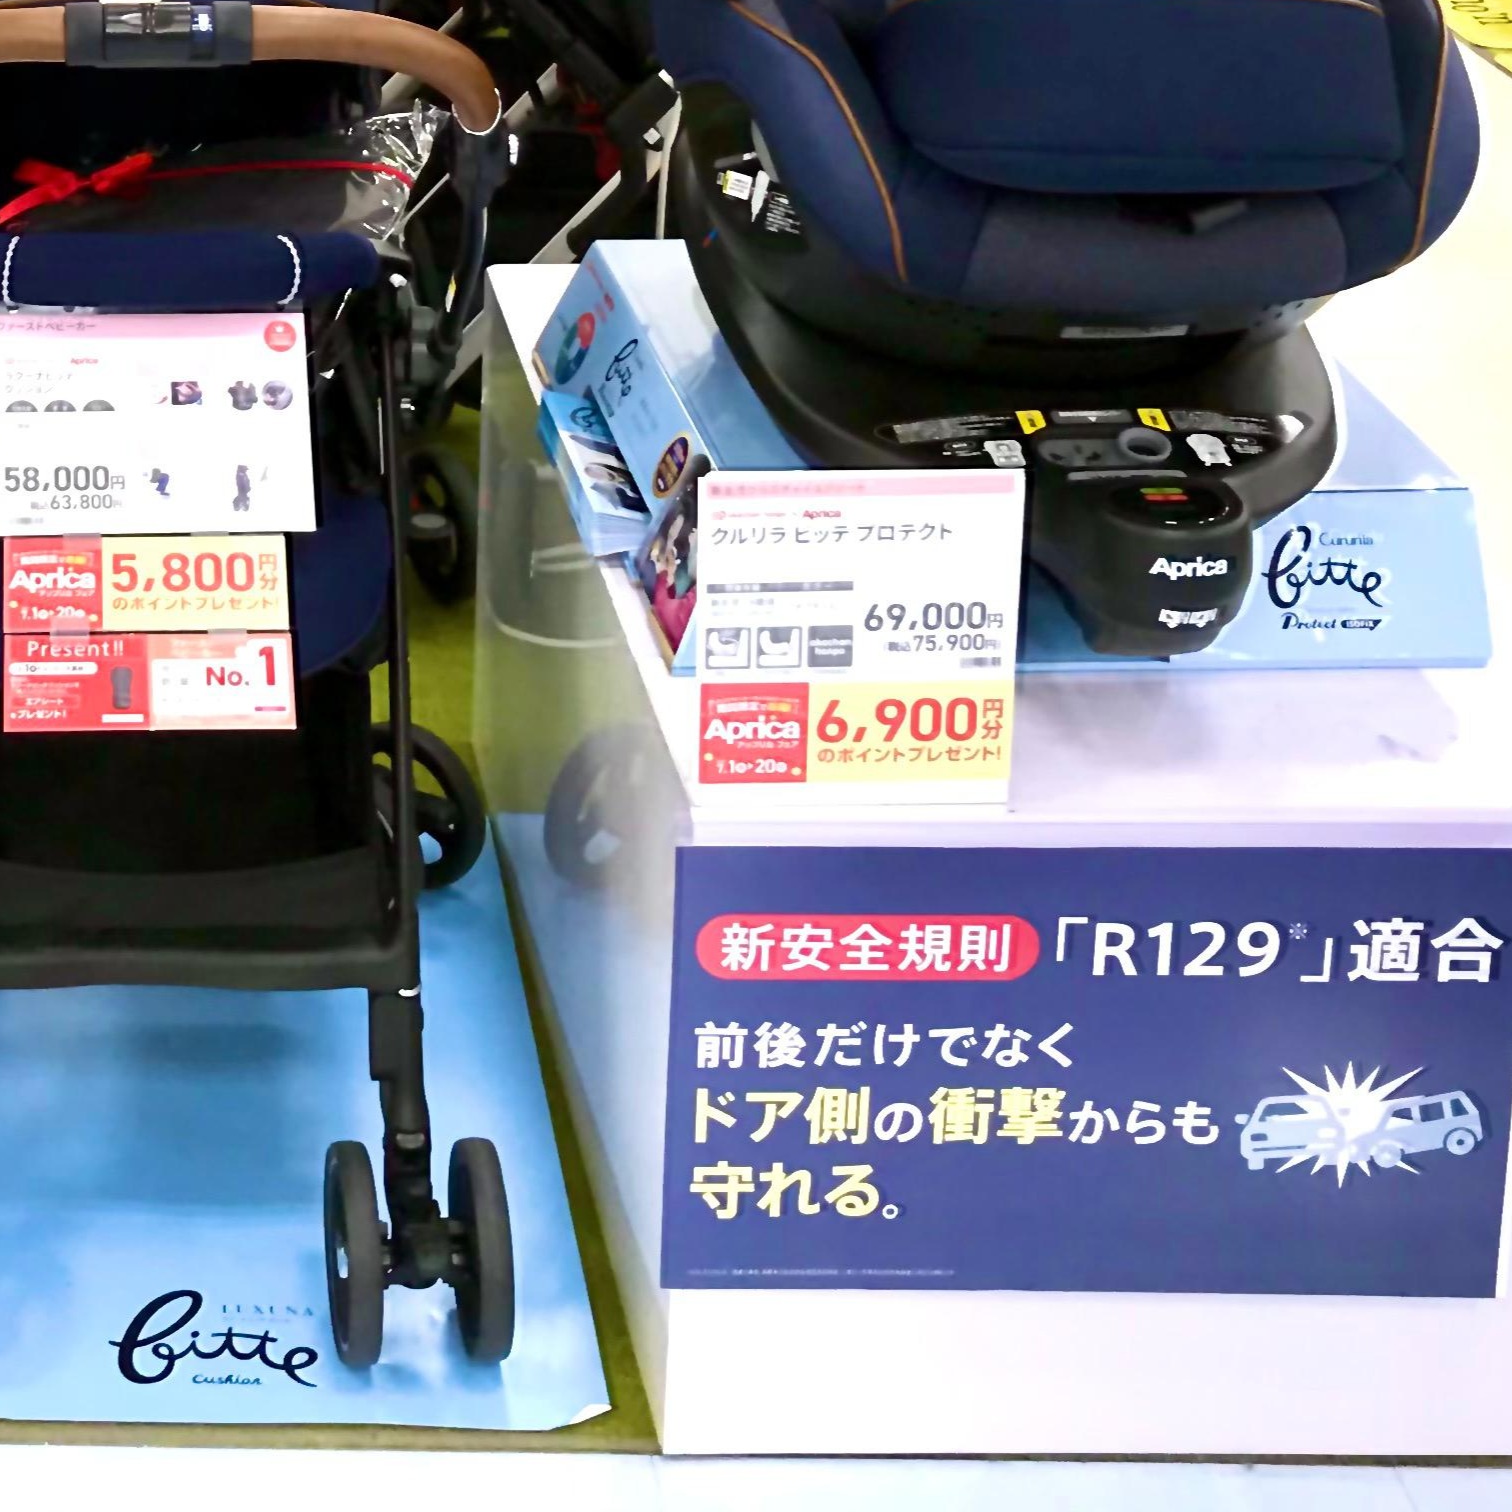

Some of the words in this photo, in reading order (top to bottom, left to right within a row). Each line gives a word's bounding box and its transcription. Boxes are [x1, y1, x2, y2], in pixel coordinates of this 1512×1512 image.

[8, 565, 96, 594] Aprica
[1148, 556, 1228, 581] Aprica
[863, 601, 1004, 632] 69,000円
[704, 714, 801, 745] Aprica
[719, 921, 1012, 975] 新安全規則
[694, 1021, 1076, 1070] 前後だけでなく
[691, 1085, 1220, 1146] ドア側の衝撃からも
[689, 1160, 902, 1222] 守れる。
